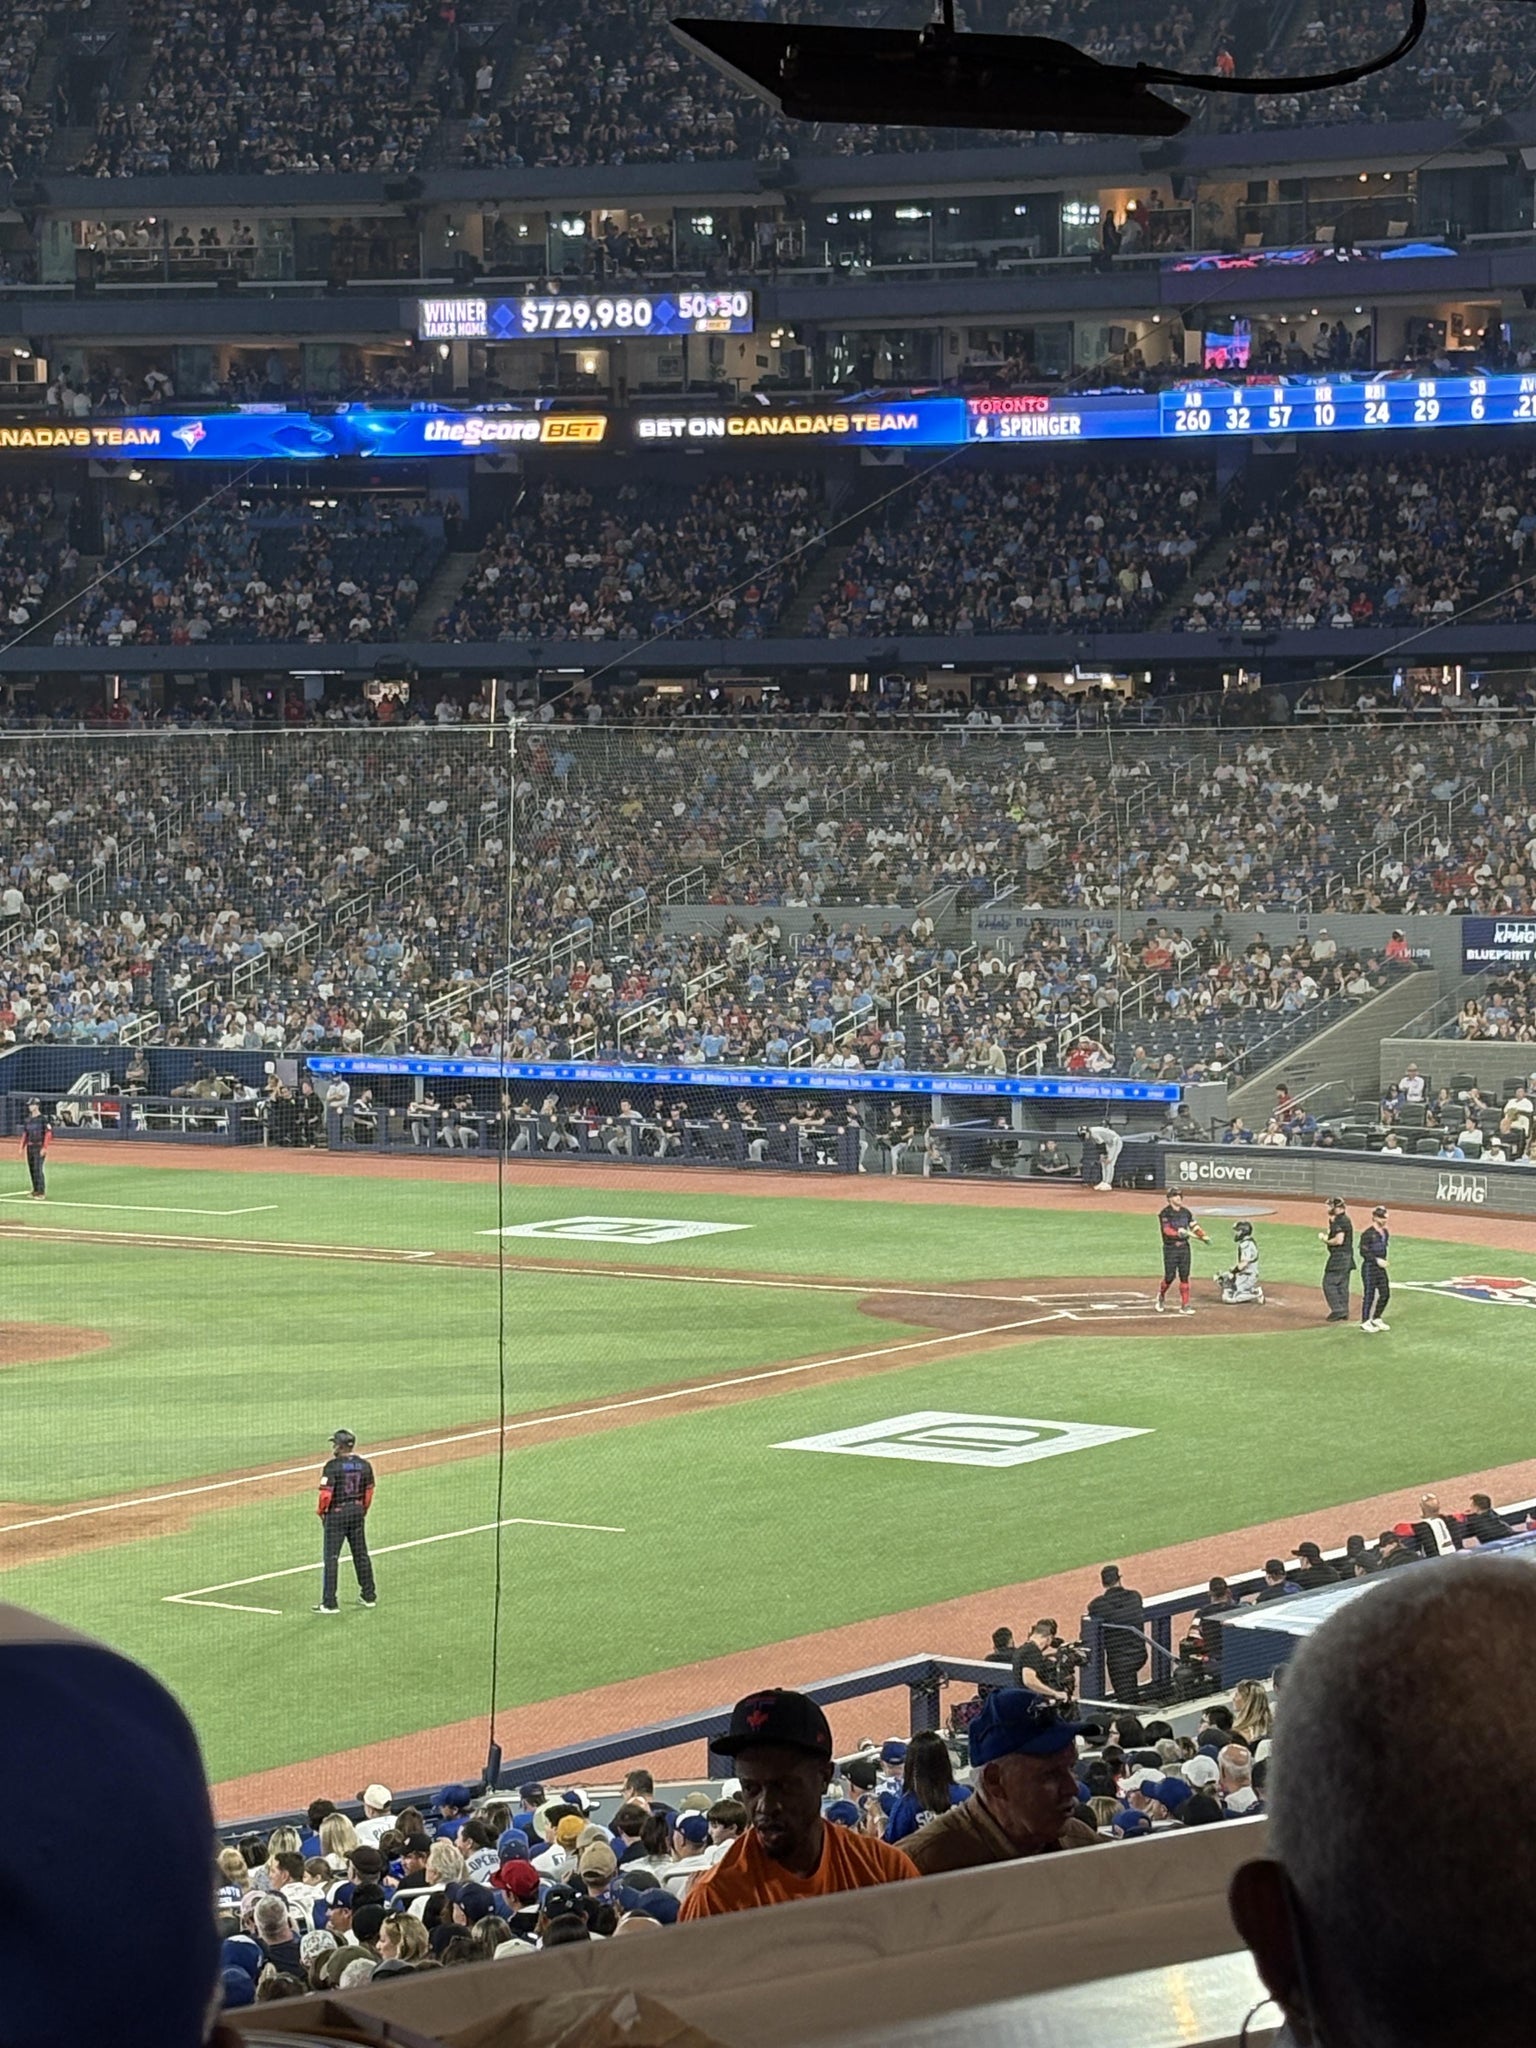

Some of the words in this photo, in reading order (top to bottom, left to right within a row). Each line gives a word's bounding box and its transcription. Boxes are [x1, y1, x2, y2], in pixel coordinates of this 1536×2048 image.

[424, 302, 487, 322] WINNER
[521, 299, 651, 333] $729,980
[424, 323, 455, 337] TAKES
[458, 322, 487, 336] HOME
[1185, 391, 1202, 408] AB
[1273, 388, 1284, 405] H
[1315, 386, 1332, 402] HR
[1365, 384, 1386, 400] RBI
[1520, 377, 1536, 393] AV
[969, 396, 1049, 415] TORONTO
[1174, 408, 1211, 431] 260
[1225, 407, 1250, 430] 32
[1268, 406, 1292, 427] 57
[1315, 404, 1335, 426] 10
[1364, 402, 1390, 424] 24
[1414, 399, 1439, 422] 29
[1471, 398, 1485, 419] 6
[424, 420, 540, 446] theScore
[547, 422, 597, 438] BET
[639, 418, 685, 437] BET
[690, 418, 724, 437] ON
[727, 415, 849, 436] CANADA'S
[851, 415, 919, 433] TEAM
[974, 418, 988, 437] 4
[1000, 416, 1081, 436] SPRINGER
[94, 428, 161, 446] TEAM
[1494, 927, 1535, 944] KPMG
[1466, 949, 1531, 961] BLUEPRINT
[1199, 1160, 1253, 1180] clover
[1436, 1180, 1485, 1203] KPMG
